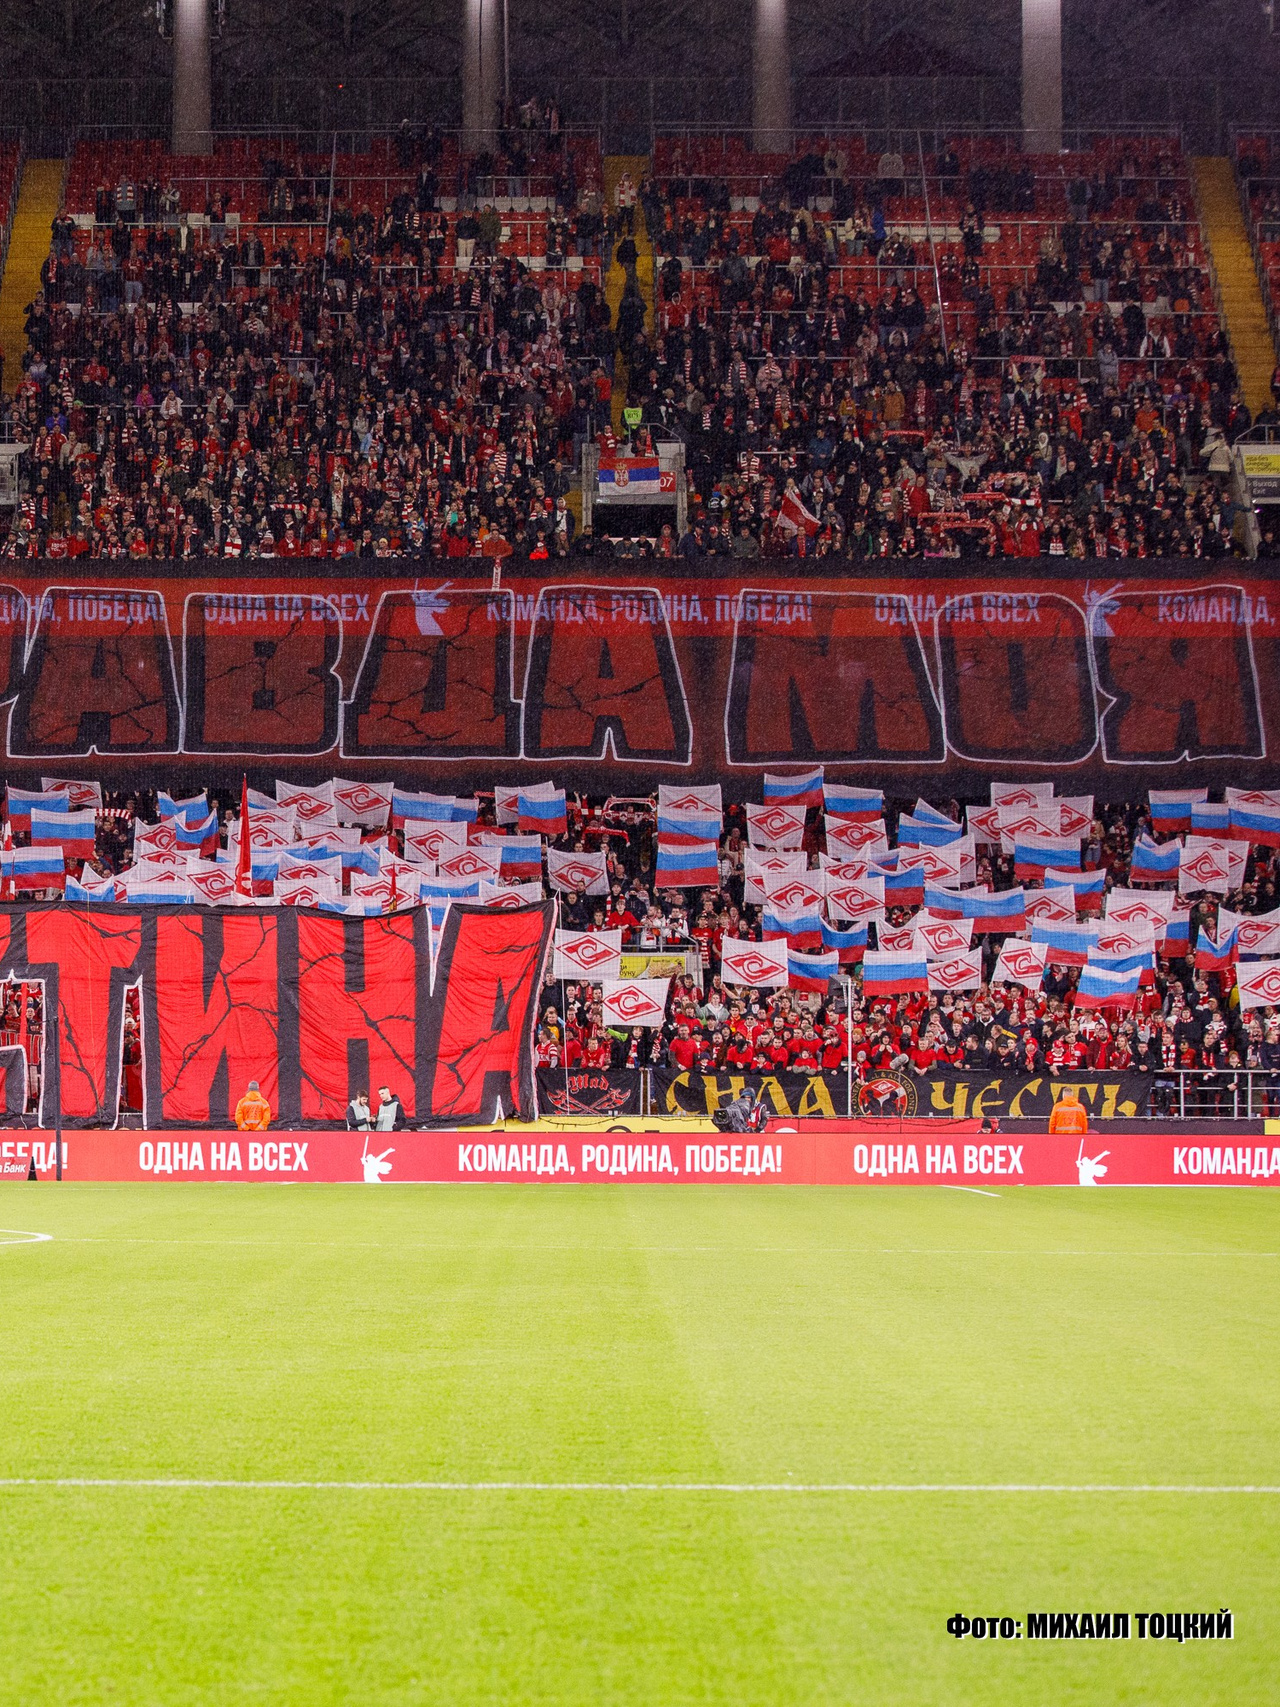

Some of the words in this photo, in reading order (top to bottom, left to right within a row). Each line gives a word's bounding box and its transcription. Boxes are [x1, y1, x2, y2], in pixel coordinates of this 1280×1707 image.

[660, 477, 673, 487] 07
[68, 595, 164, 625] ПОБЕДА!
[204, 594, 267, 625] ОДНА
[311, 594, 370, 622] ВСЕХ
[487, 593, 604, 626] КОМАНДА,
[716, 595, 813, 625] ПОБЕДА!
[874, 595, 938, 625] ОДНА
[945, 595, 976, 622] НА
[982, 595, 1040, 622] ВСЕХ
[1158, 595, 1276, 628] КОМАНДА,
[725, 584, 1266, 765] МОЯ
[3, 1162, 26, 1173] Банк
[139, 1142, 205, 1172] ОДНА
[211, 1142, 241, 1170] НА
[248, 1142, 308, 1171] ВСЕХ
[458, 1144, 576, 1176] КОМАНДА,
[582, 1144, 679, 1176] РОДИНА,
[685, 1144, 782, 1176] ПОБЕДА!
[854, 1145, 920, 1176] ОДНА
[926, 1145, 958, 1174] НА
[964, 1145, 1024, 1174] ВСЕХ
